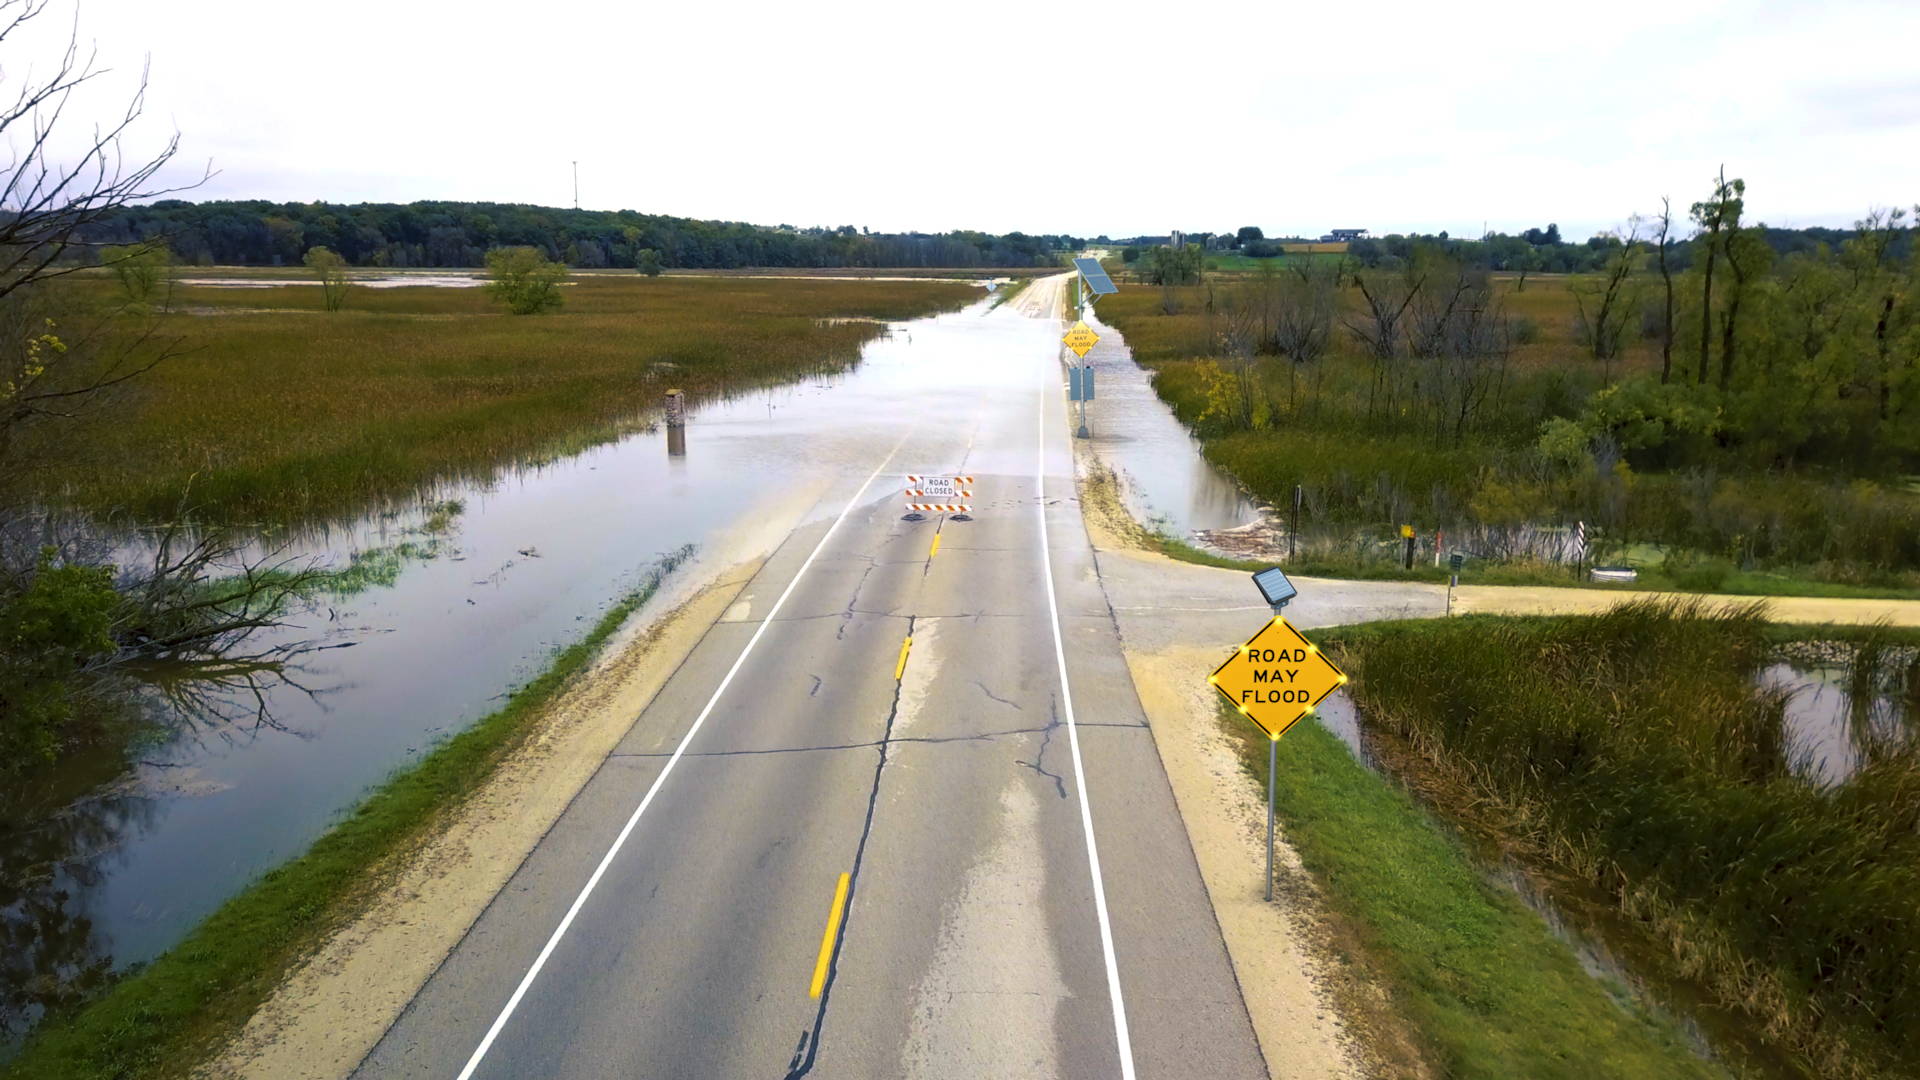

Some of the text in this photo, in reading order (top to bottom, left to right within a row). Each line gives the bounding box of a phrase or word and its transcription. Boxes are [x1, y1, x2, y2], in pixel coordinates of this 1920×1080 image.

[925, 487, 953, 495] CLOSED
[1248, 649, 1306, 662] ROAD
[1254, 669, 1299, 683] MAY
[1242, 690, 1310, 703] FLOOD
